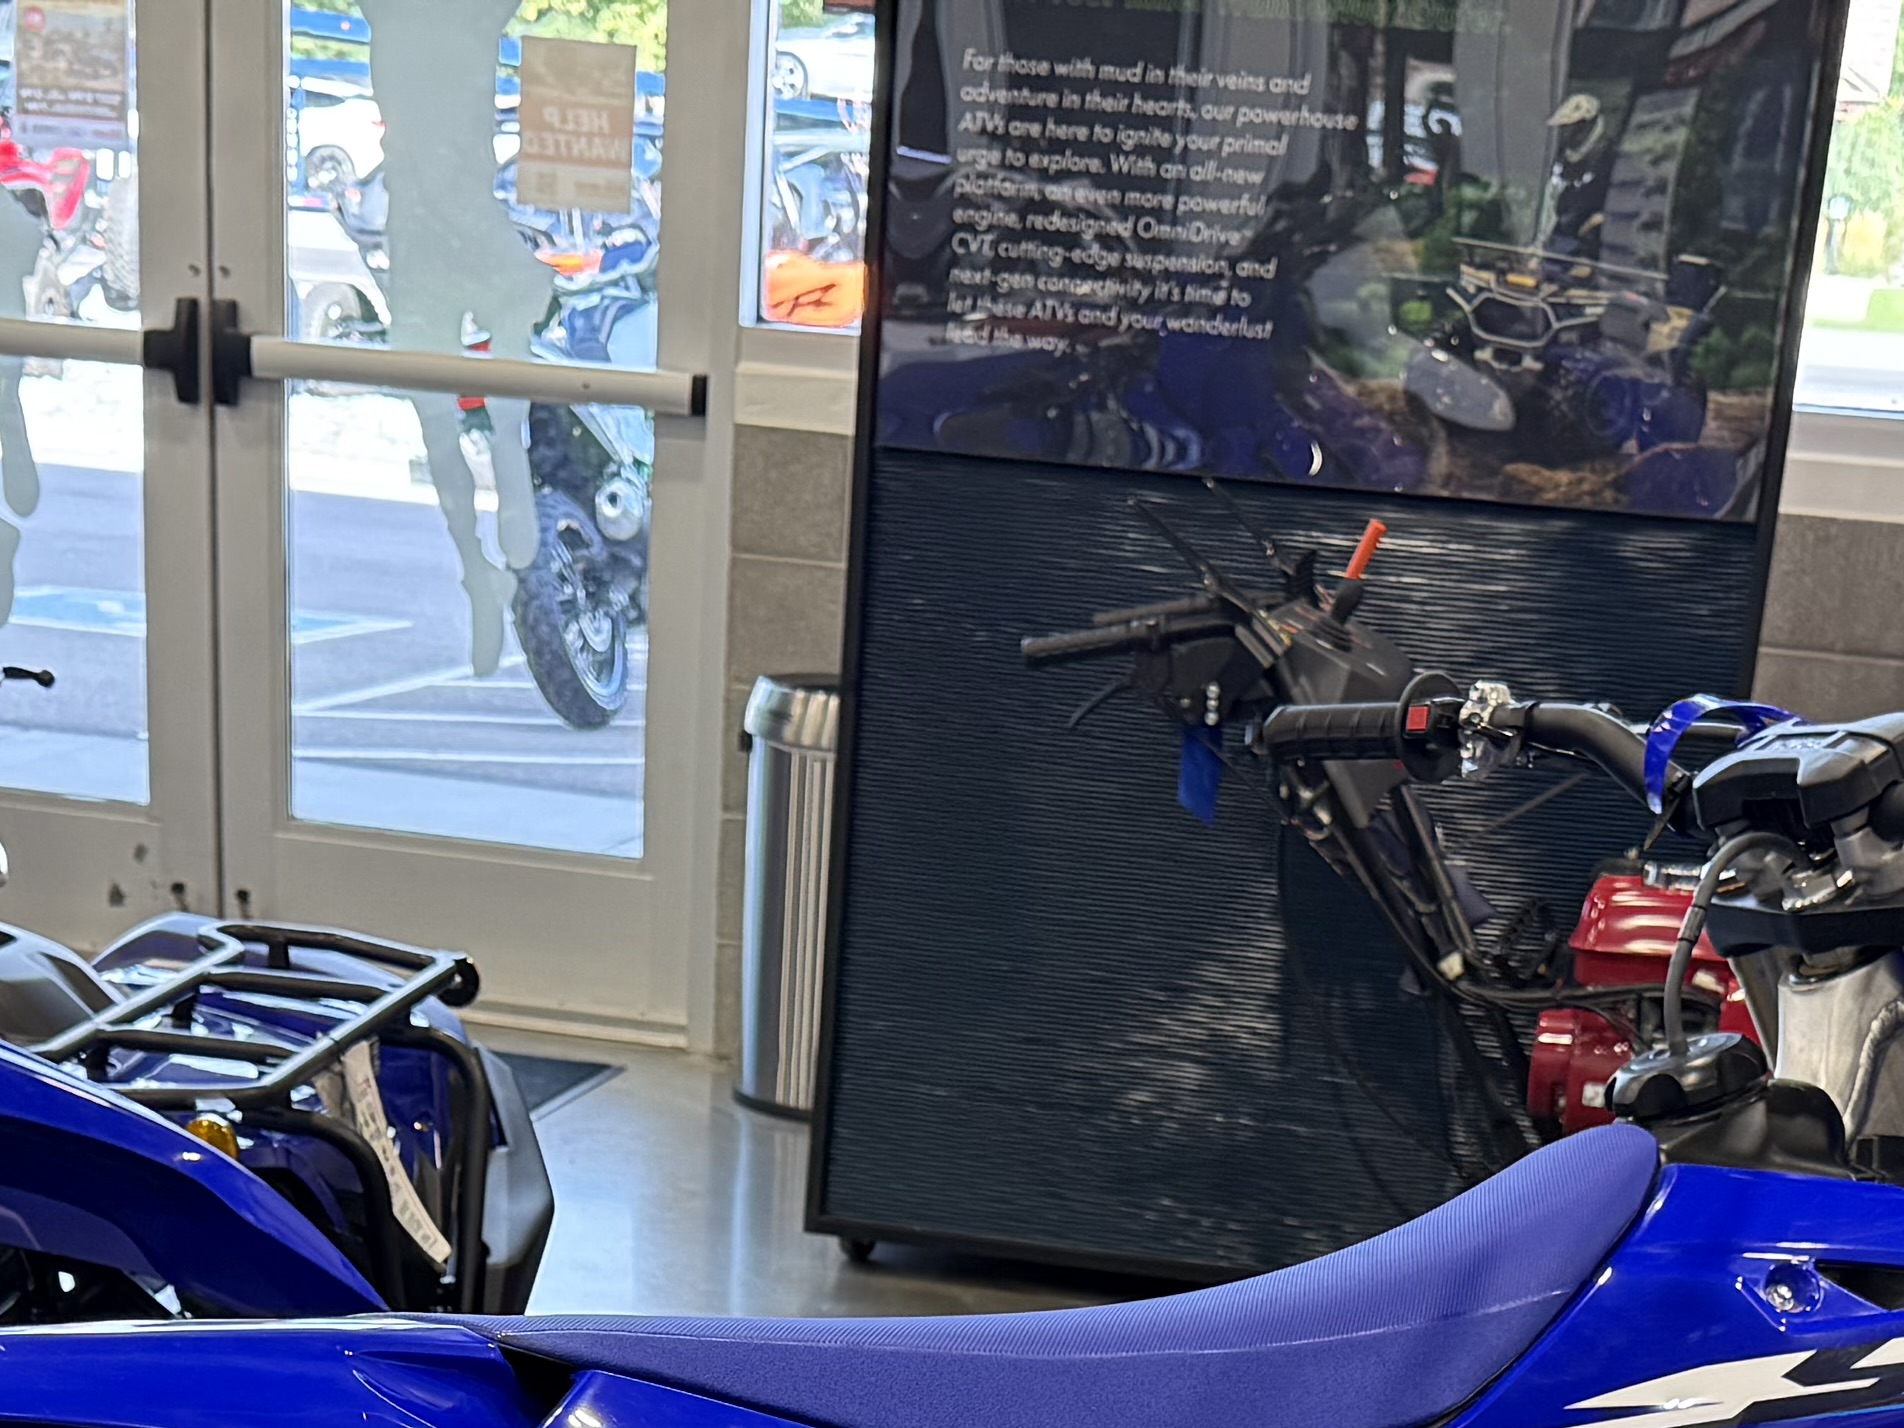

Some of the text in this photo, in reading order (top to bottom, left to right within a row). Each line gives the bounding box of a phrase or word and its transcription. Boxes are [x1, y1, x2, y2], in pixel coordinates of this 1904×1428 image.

[962, 49, 1311, 96] For those with mud in their veins and
[960, 81, 1059, 108] adventure
[1062, 88, 1081, 109] in
[1084, 89, 1128, 113] their
[1201, 104, 1235, 122] our
[1236, 102, 1359, 132] powerhouse
[958, 109, 1289, 158] ATVs are here to ignite your primal
[956, 146, 1266, 186] urge to explore. With an all-new
[1071, 185, 1123, 206] even
[1124, 188, 1175, 210] more
[1177, 190, 1267, 219] powerful
[952, 206, 1023, 233] engine,
[1026, 209, 1134, 240] redesigned
[998, 240, 1121, 270] cutting-edge
[1236, 256, 1277, 280] and
[949, 265, 1252, 308] next-gen connectivity it's time to
[947, 292, 1273, 341] let these ATVs and your wanderlust
[945, 321, 1071, 355] lead the way.
